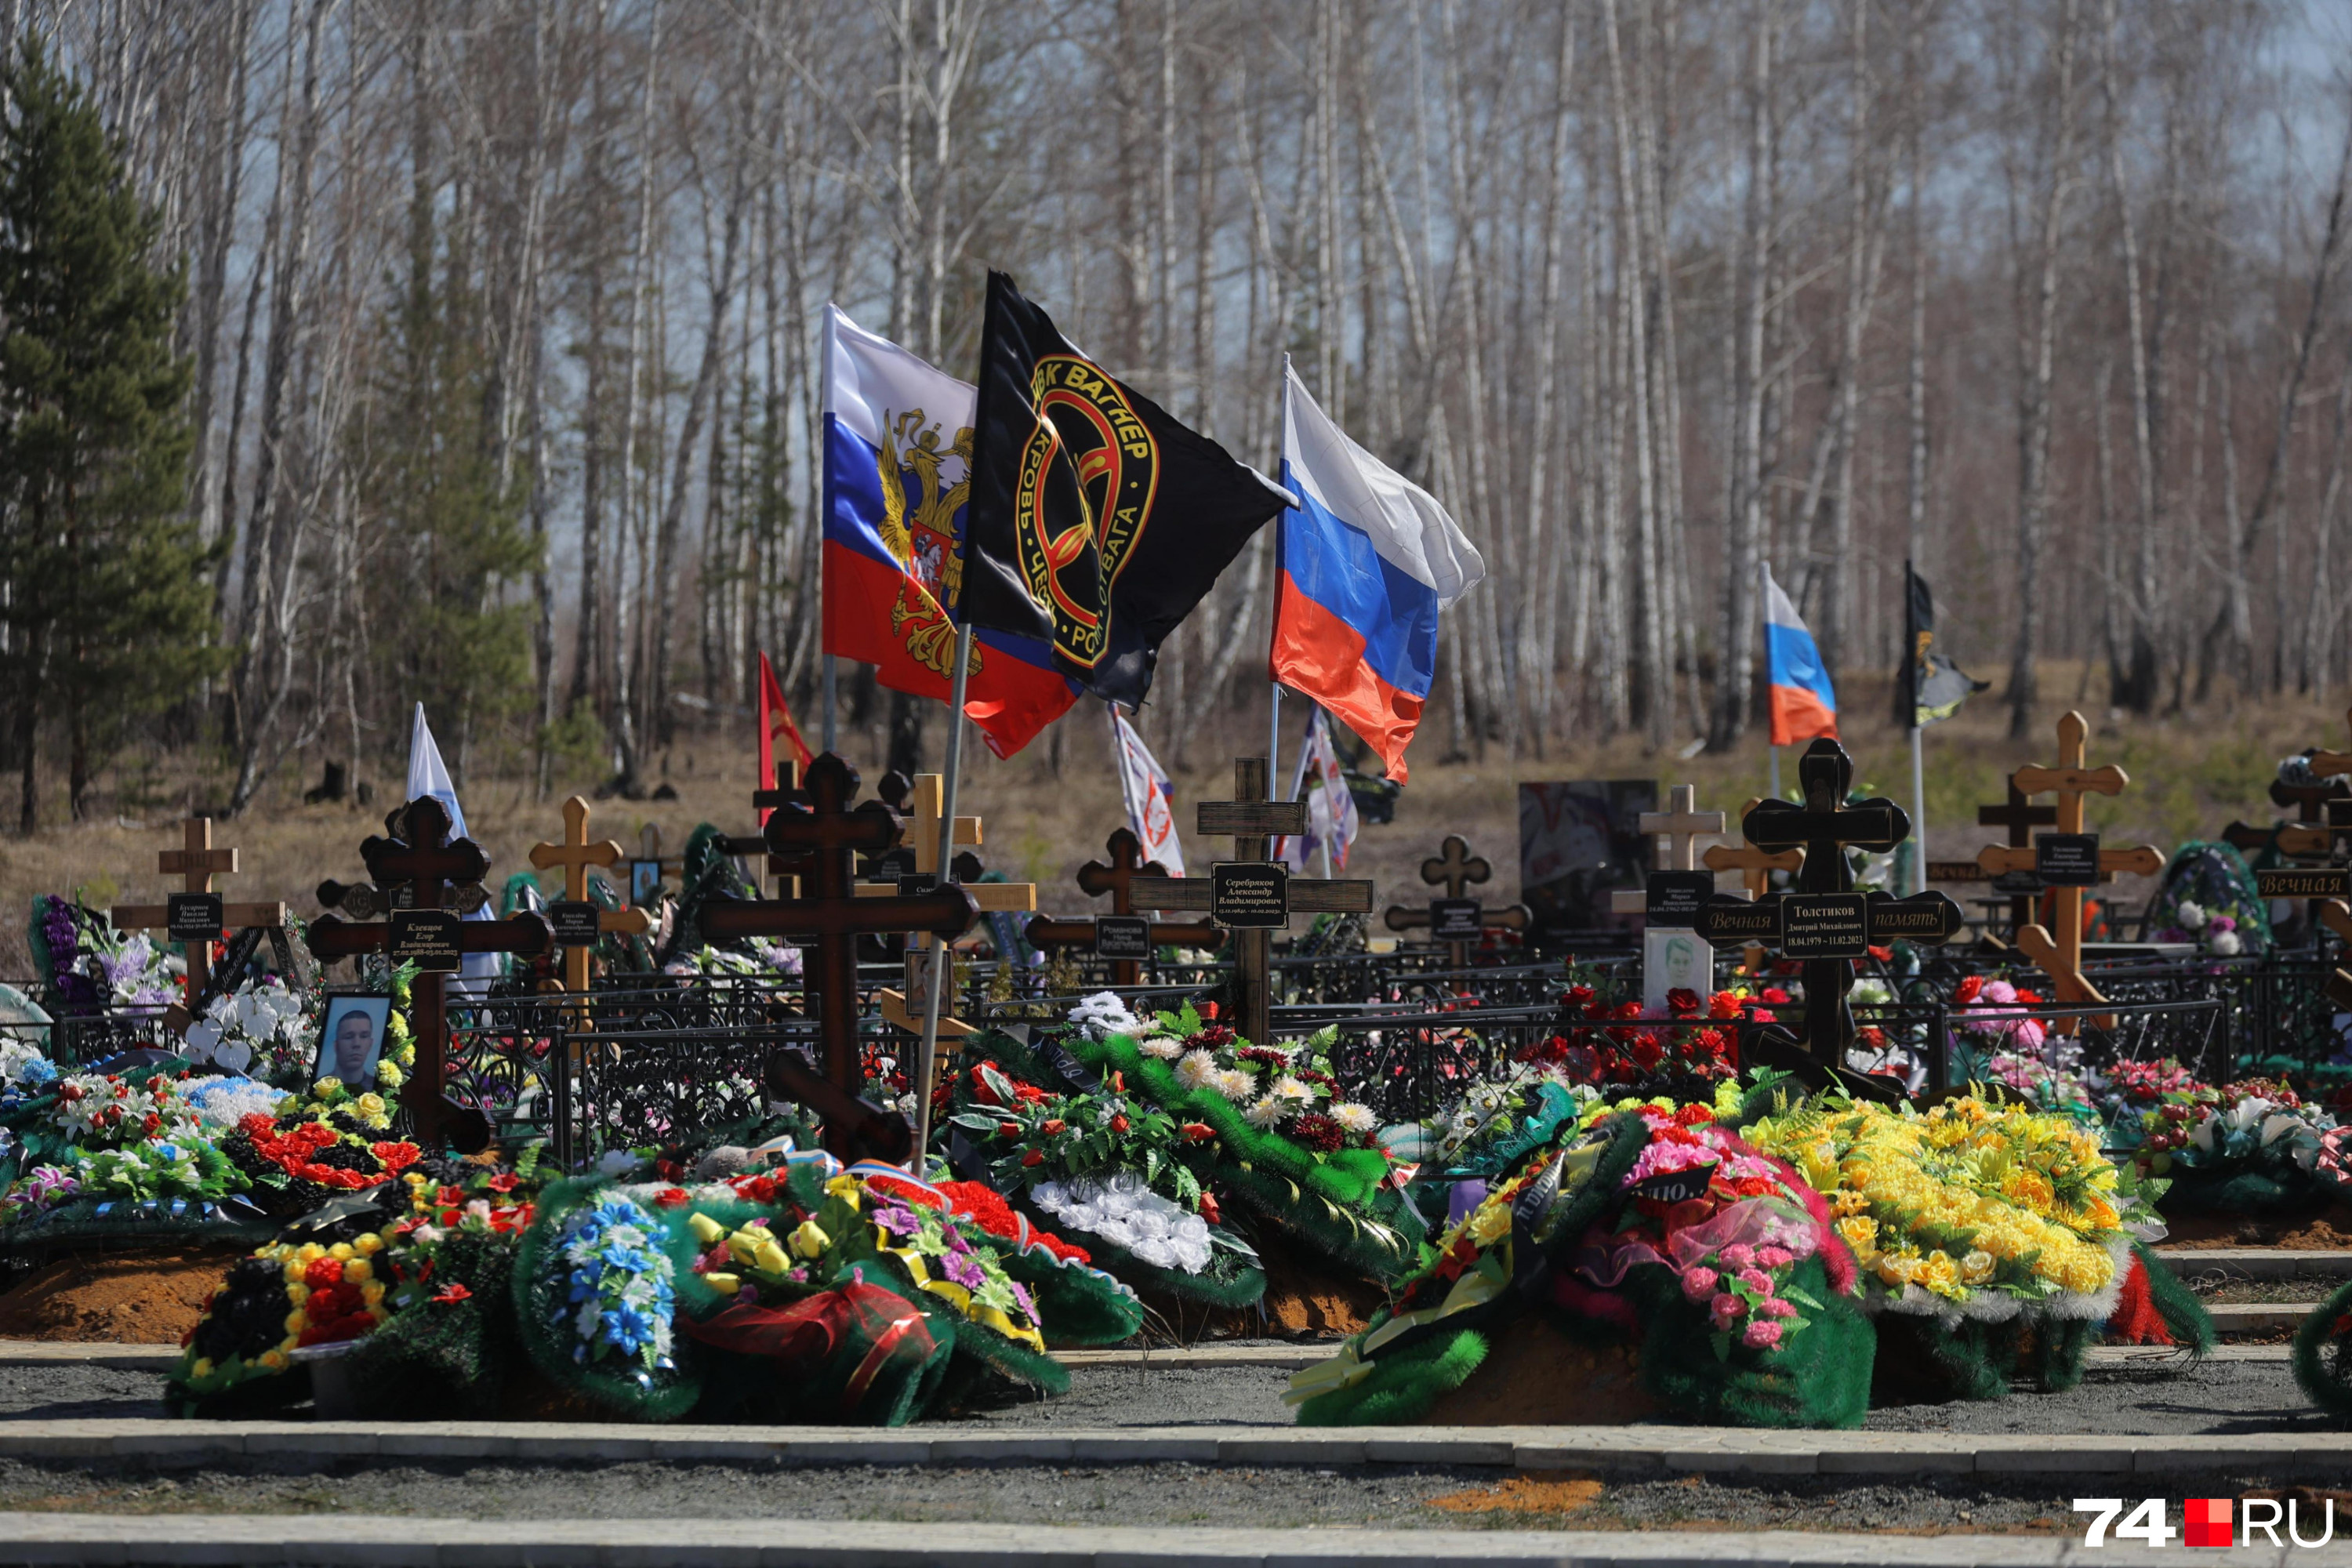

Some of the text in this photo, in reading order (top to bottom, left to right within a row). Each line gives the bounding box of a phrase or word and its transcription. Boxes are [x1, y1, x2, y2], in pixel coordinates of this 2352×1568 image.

[1064, 365, 1148, 458] ВАГНЕР
[1021, 433, 1050, 529] КРОВЬ
[1099, 506, 1138, 606] ОТВАГА
[1225, 878, 1274, 887] Серебряков
[2261, 874, 2341, 893] Вечная
[1228, 887, 1272, 897] Александр
[1218, 897, 1282, 906] Владимирович
[1793, 906, 1856, 917] Толстиков
[1709, 910, 1938, 929] Вечная память
[407, 923, 443, 933] Клевцов
[1788, 922, 1862, 932] Дмитрий Михайлович
[416, 932, 435, 942] Егор
[1788, 936, 1822, 946] 18.04.1979
[1829, 935, 1863, 946] 11.02.2023
[400, 940, 450, 949] Владимирович
